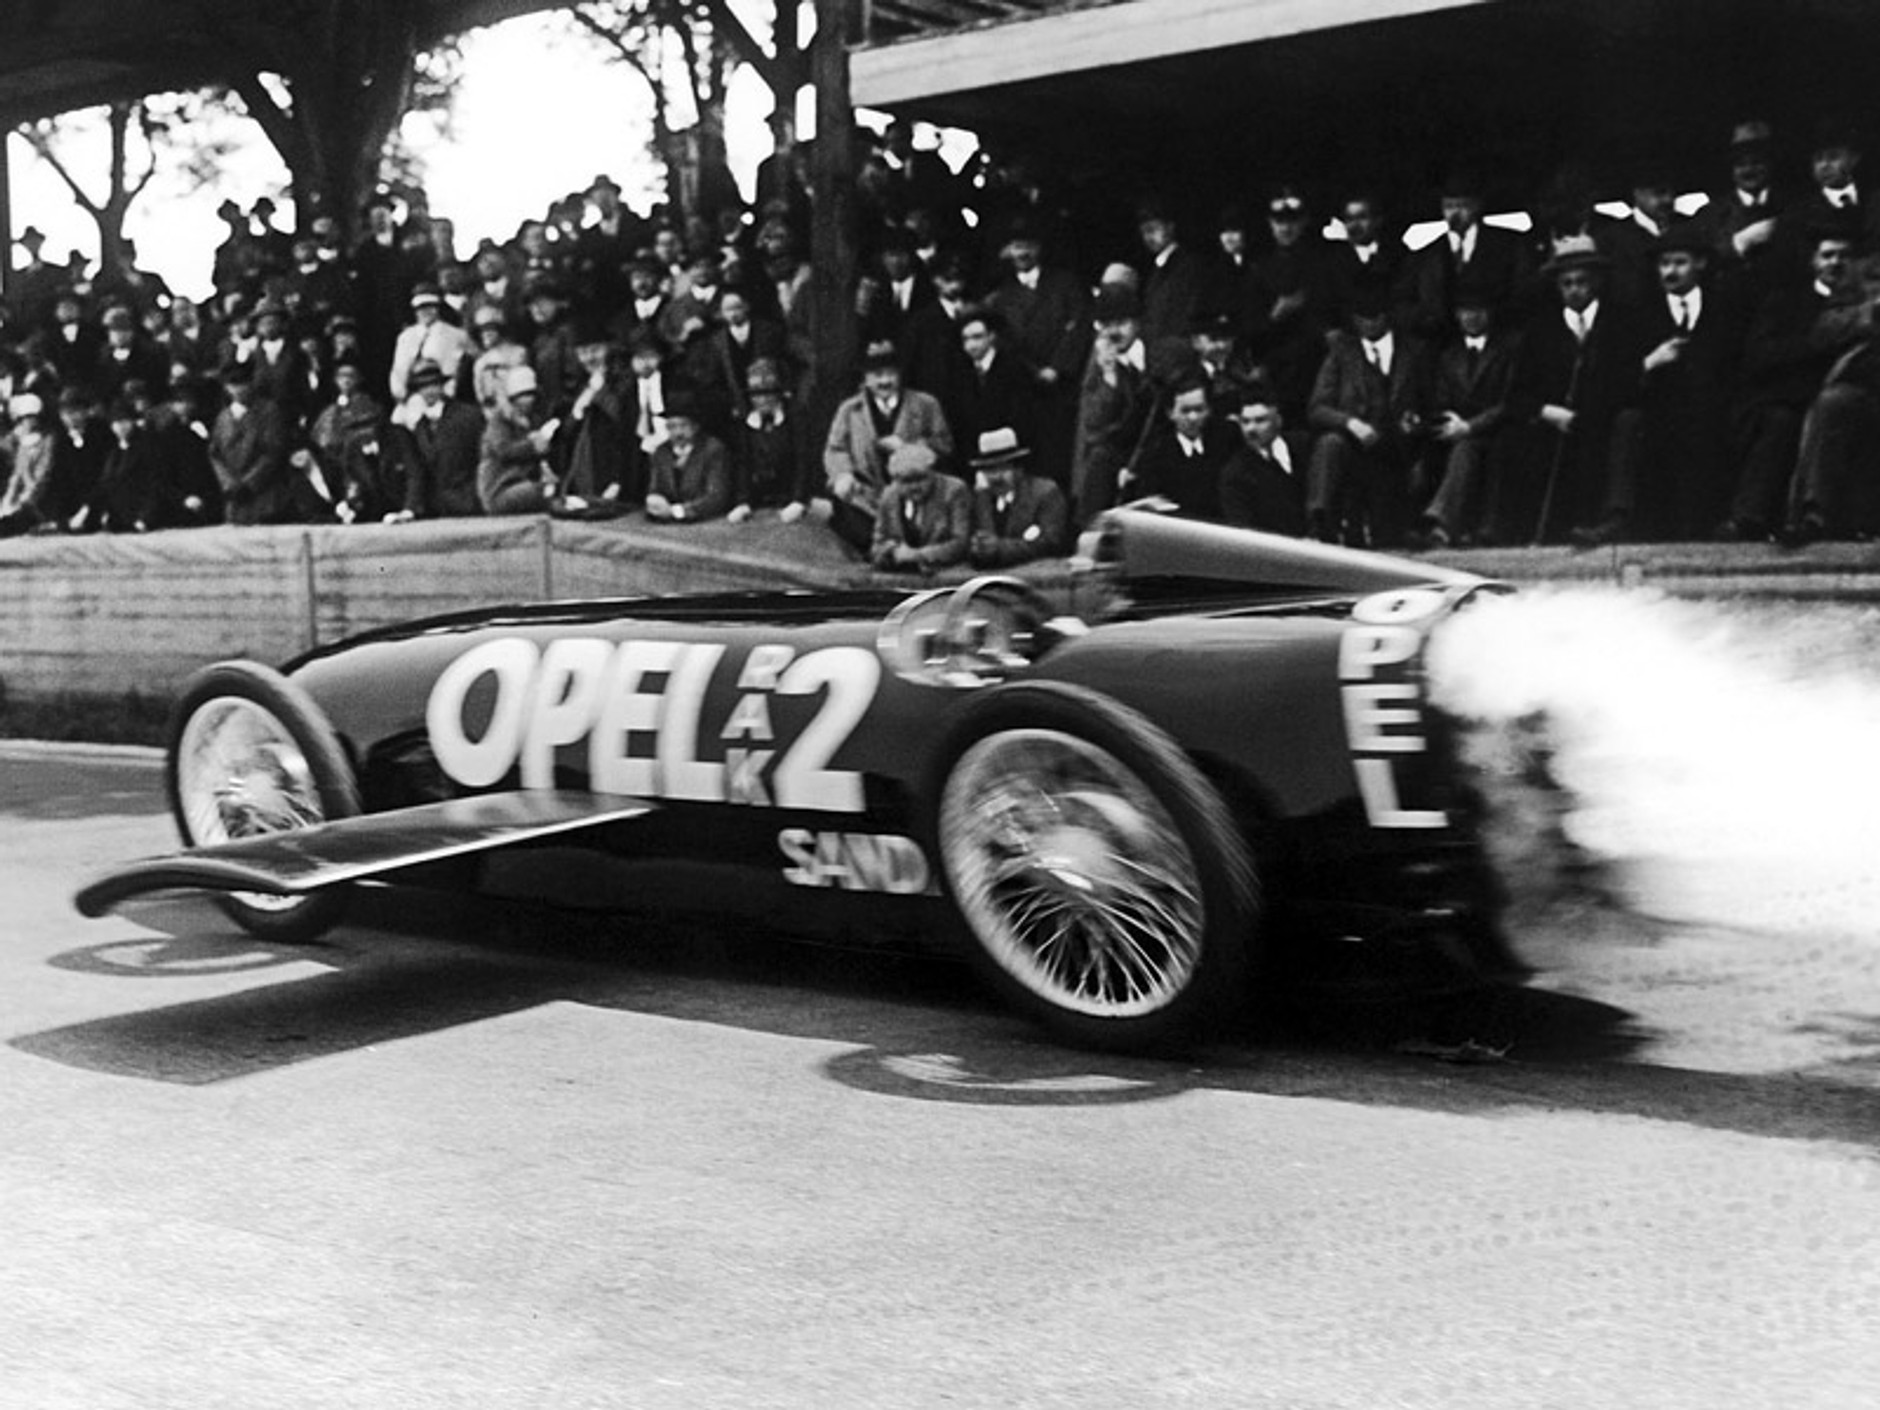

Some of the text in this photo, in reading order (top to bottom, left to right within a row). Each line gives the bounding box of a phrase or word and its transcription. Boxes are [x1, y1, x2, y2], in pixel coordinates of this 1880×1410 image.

[425, 637, 882, 812] OPEL RAK 2
[1337, 588, 1449, 828] OPEL
[777, 827, 944, 897] SAND
